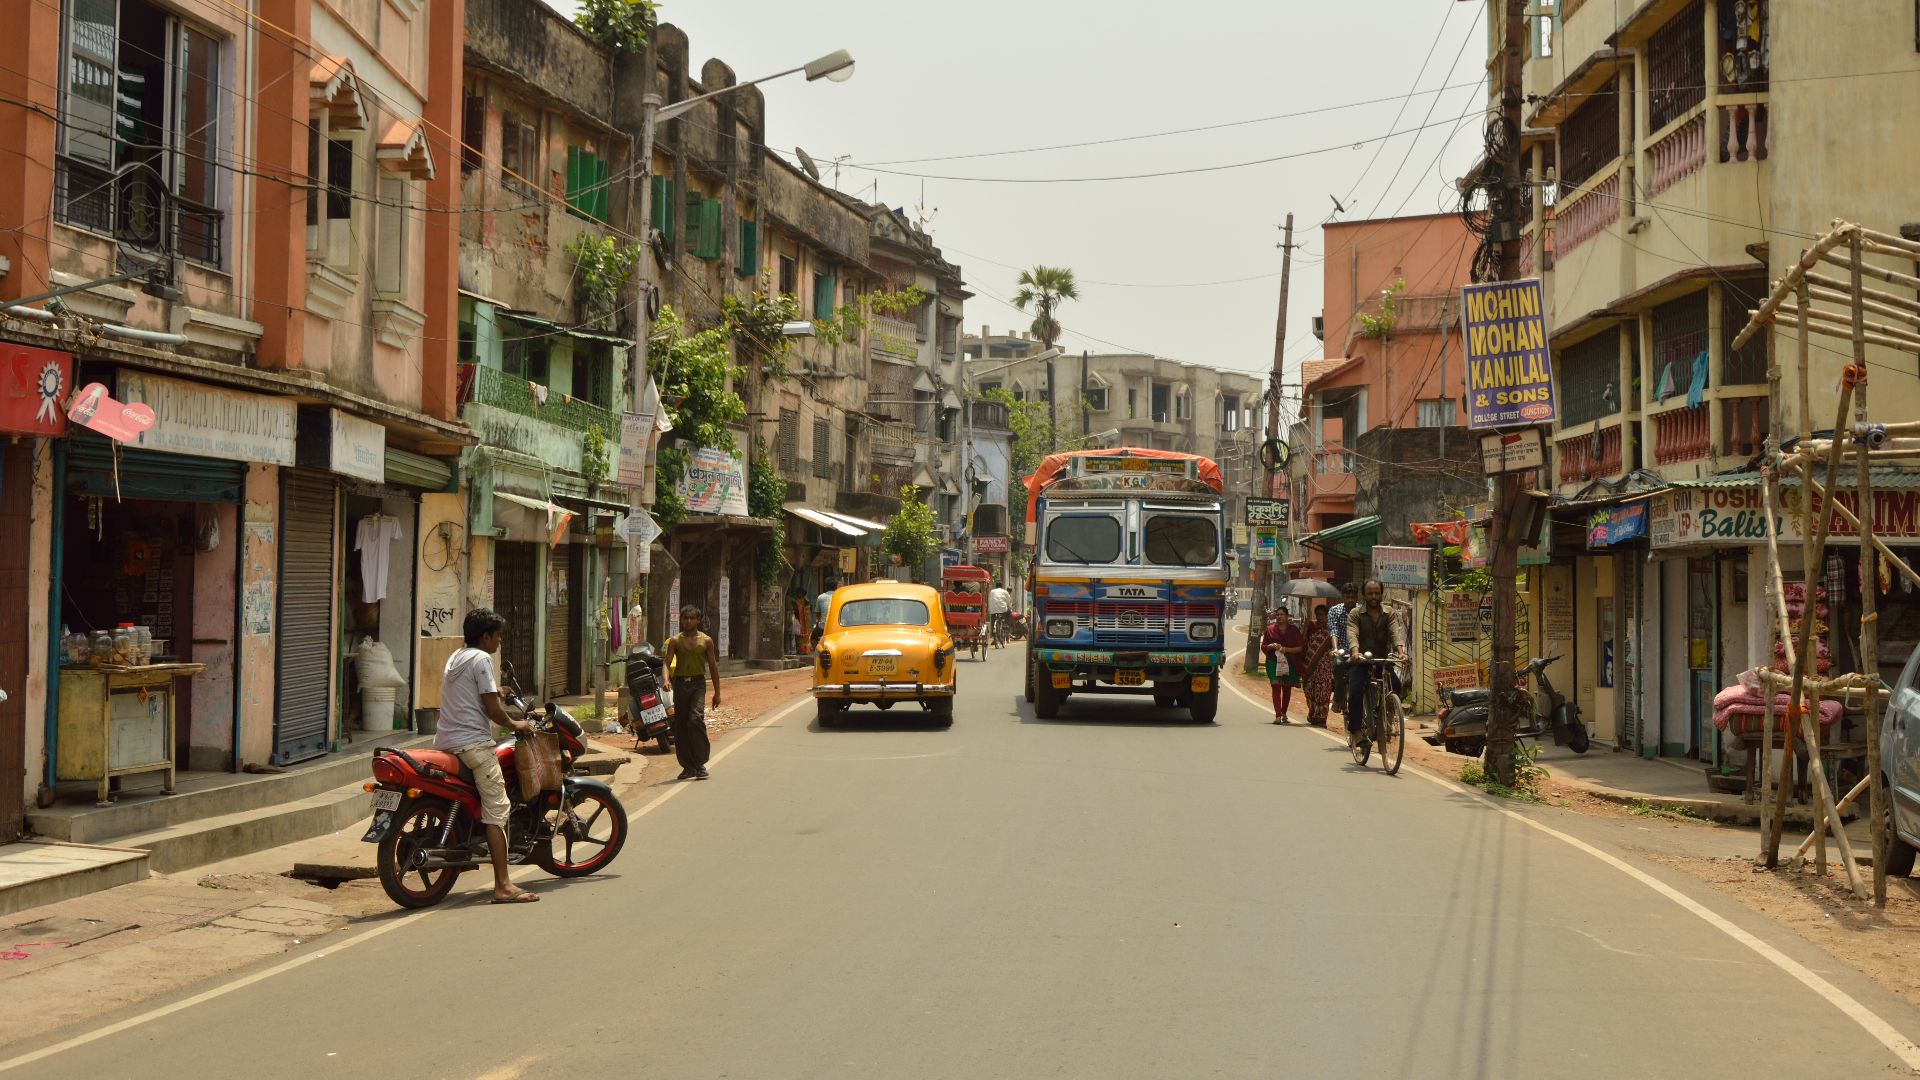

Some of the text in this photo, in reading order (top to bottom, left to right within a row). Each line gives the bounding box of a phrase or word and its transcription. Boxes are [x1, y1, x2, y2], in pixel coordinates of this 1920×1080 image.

[1467, 286, 1540, 323] MOHINI
[1470, 319, 1544, 356] MOHAN
[1471, 353, 1549, 390] KANJILAL
[1475, 387, 1550, 408] & SONS
[1474, 406, 1549, 423] COLLEGE STREET JUNCTION
[1701, 488, 1790, 508] TOSHK
[1118, 588, 1146, 596] TATA
